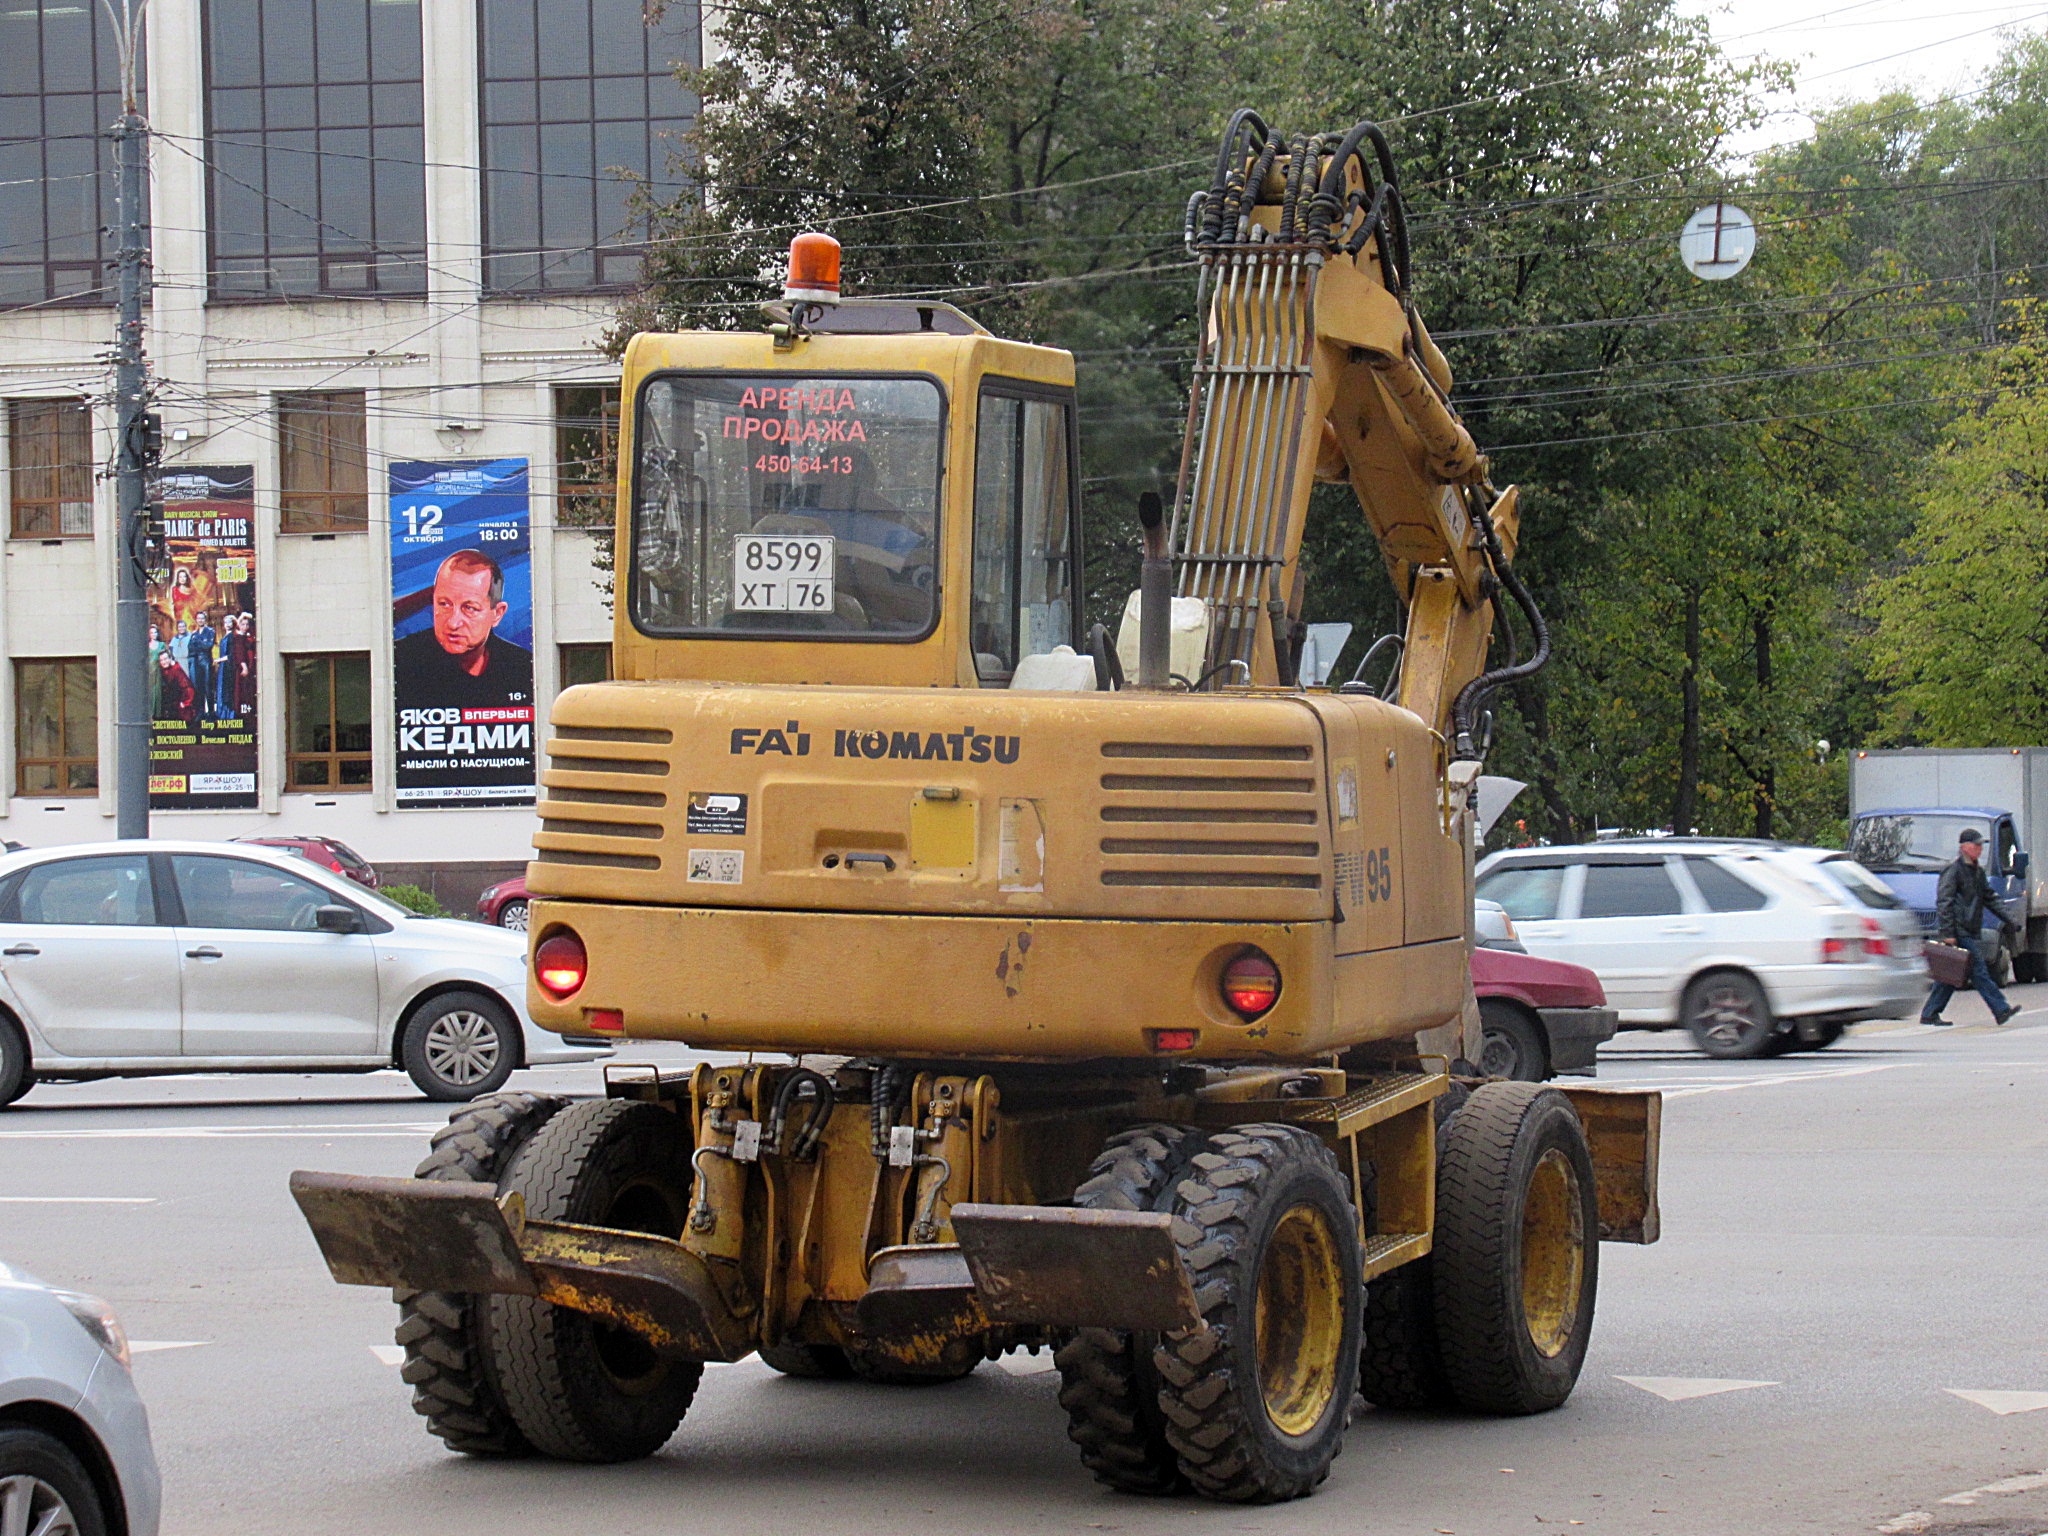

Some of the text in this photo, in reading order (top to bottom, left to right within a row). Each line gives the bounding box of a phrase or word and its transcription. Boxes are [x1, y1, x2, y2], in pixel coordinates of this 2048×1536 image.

[739, 387, 856, 414] АРЕНДА
[723, 417, 866, 445] ПРОДАЖА
[755, 455, 852, 474] 450-64-13
[165, 518, 247, 537] DAME de PARIS
[402, 505, 443, 535] 12
[200, 538, 218, 546] ROMEO
[224, 537, 247, 546] JULIETTE
[403, 535, 443, 543] октября
[480, 529, 518, 541] 18:00
[746, 541, 822, 572] 8599
[796, 584, 825, 607] 76
[508, 692, 527, 701] 16+
[241, 704, 252, 714] 12+
[400, 708, 529, 725] ЯКОВ ВПЕРВЫЕ!
[217, 719, 244, 729] МАРКИН
[400, 724, 530, 754] КЕДМИ
[834, 726, 1020, 764] KOMATSU
[450, 759, 458, 768] О
[151, 778, 183, 790] лет.рф
[1367, 848, 1391, 902] 95
